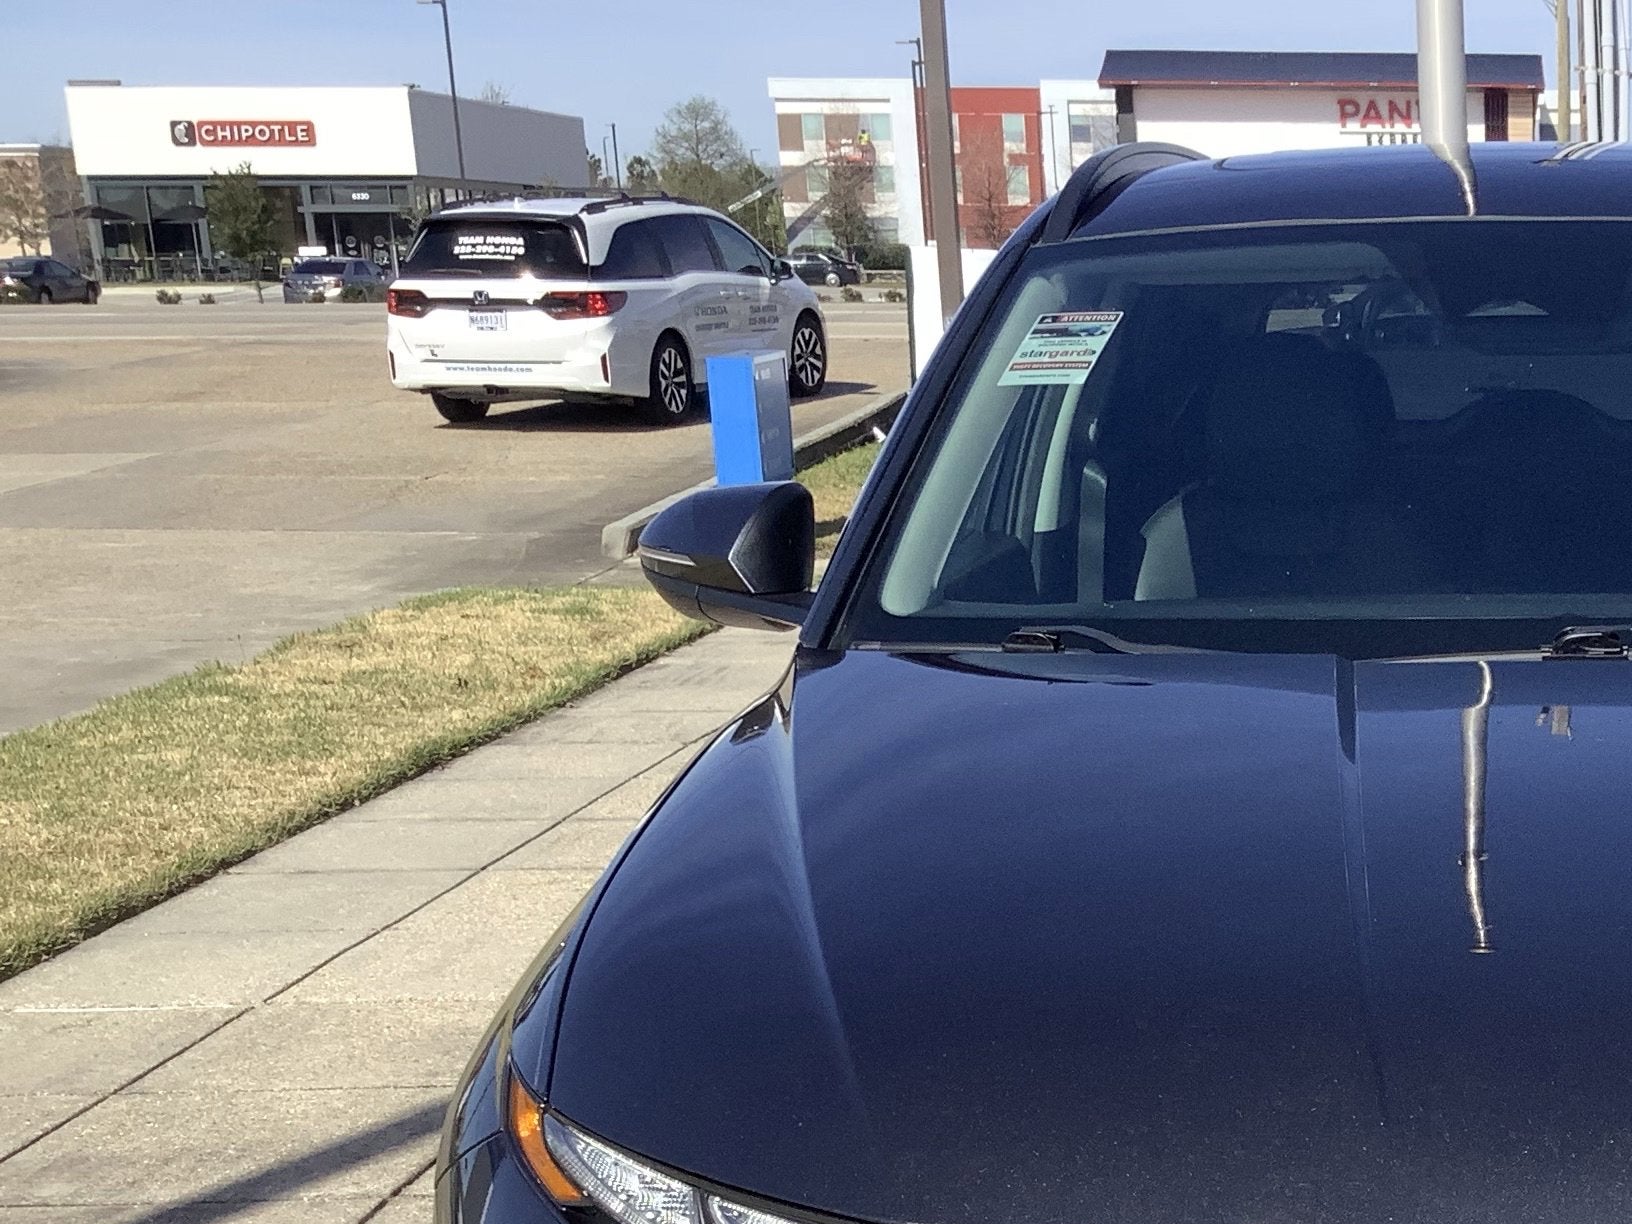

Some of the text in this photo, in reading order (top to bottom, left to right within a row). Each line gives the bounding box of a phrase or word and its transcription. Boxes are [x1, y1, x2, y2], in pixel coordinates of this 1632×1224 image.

[1337, 99, 1419, 128] PAN
[200, 125, 309, 141] CHIPOTLE
[1060, 314, 1117, 322] ATTENTION
